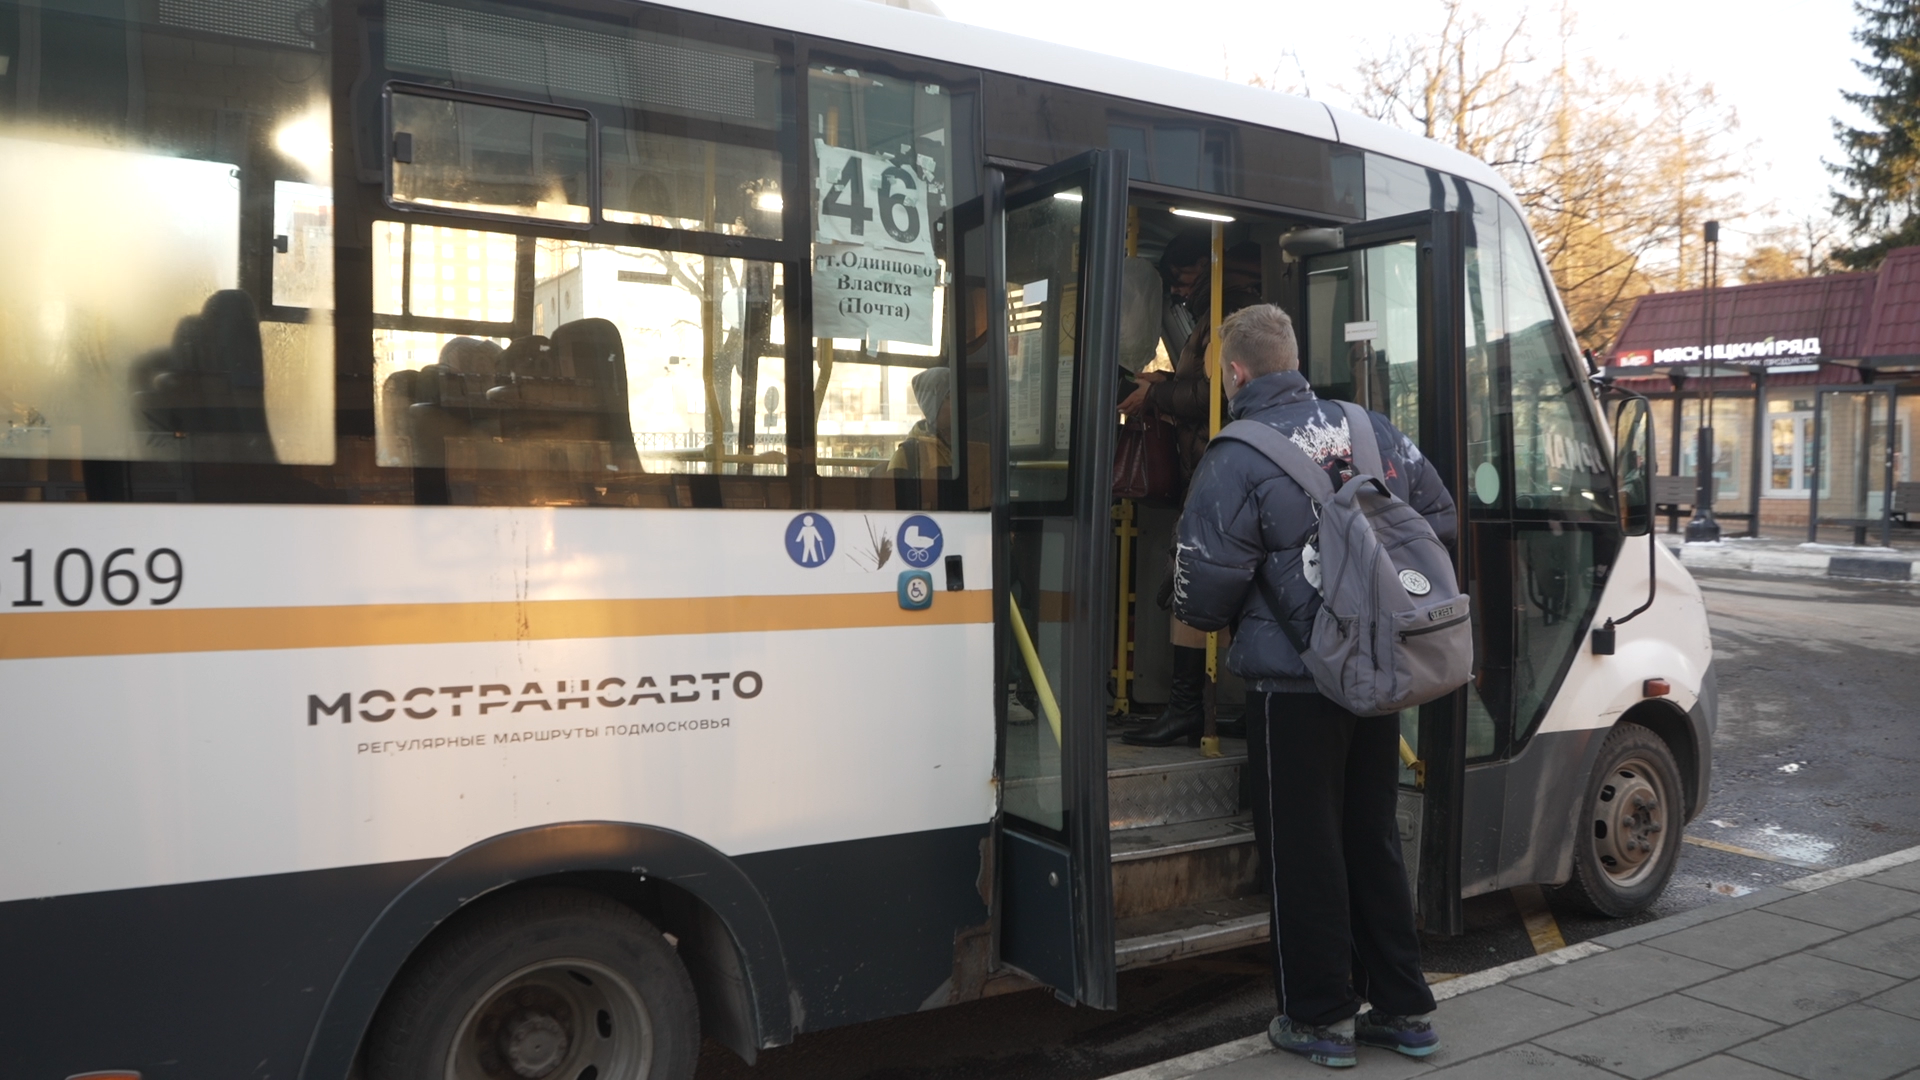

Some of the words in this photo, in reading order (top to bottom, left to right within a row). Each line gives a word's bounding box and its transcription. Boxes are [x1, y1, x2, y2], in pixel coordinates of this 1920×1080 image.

[822, 156, 921, 244] 46
[837, 274, 912, 297] Власиха
[838, 297, 910, 322] (Почта)
[1653, 338, 1774, 363] МЯСНИЦКИЙ
[1775, 337, 1821, 356] РЯД
[0, 547, 183, 607] 1069
[307, 670, 764, 727] МОСТРАНСАВТО
[357, 733, 487, 755] РЕГУЛЯРНЫЕ
[493, 726, 599, 745] МАРШРУТЫ
[604, 717, 731, 737] ПОДМОСКОВЬЯ
